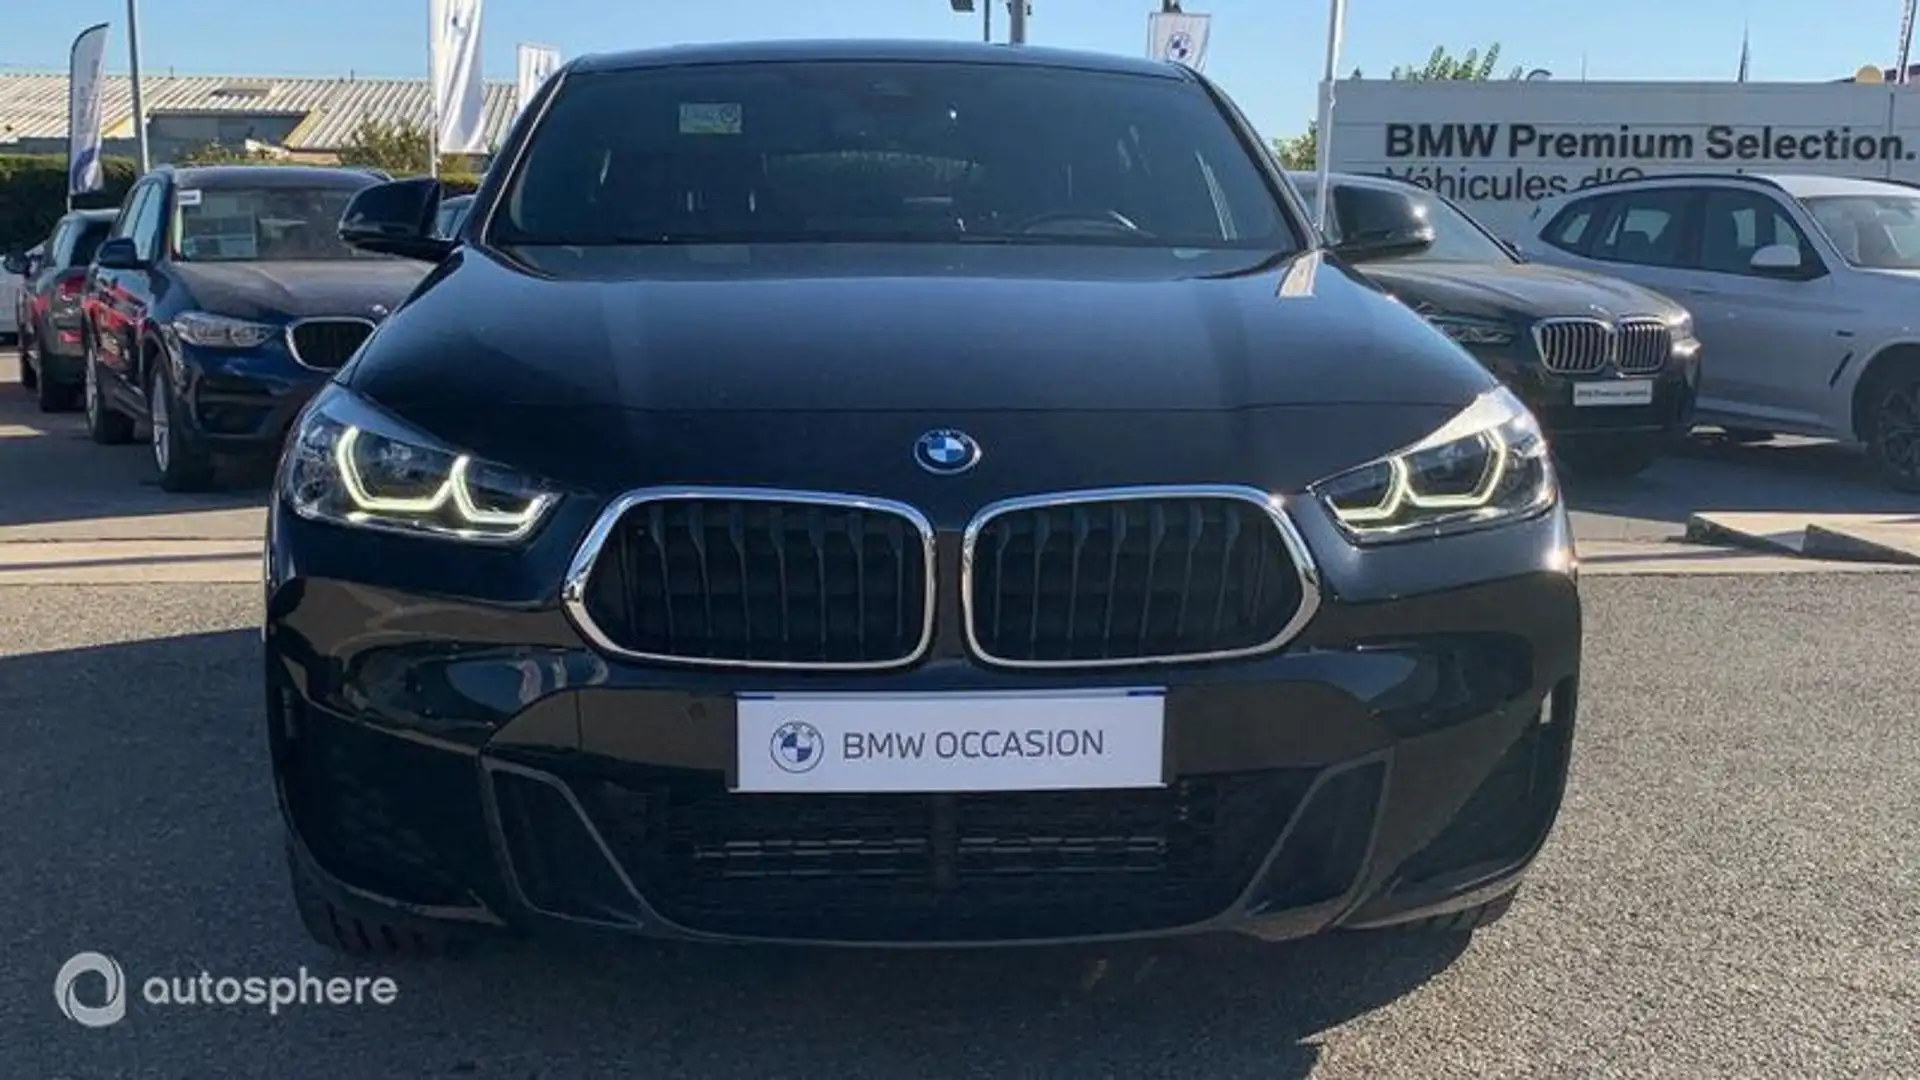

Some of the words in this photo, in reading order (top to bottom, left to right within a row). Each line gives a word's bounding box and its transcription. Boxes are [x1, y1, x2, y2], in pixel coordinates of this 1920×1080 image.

[1386, 123, 1499, 158] BMW
[1508, 124, 1694, 159] Premium
[1706, 125, 1916, 160] Selection.
[843, 731, 926, 760] BMW
[935, 729, 1104, 758] OCCASION
